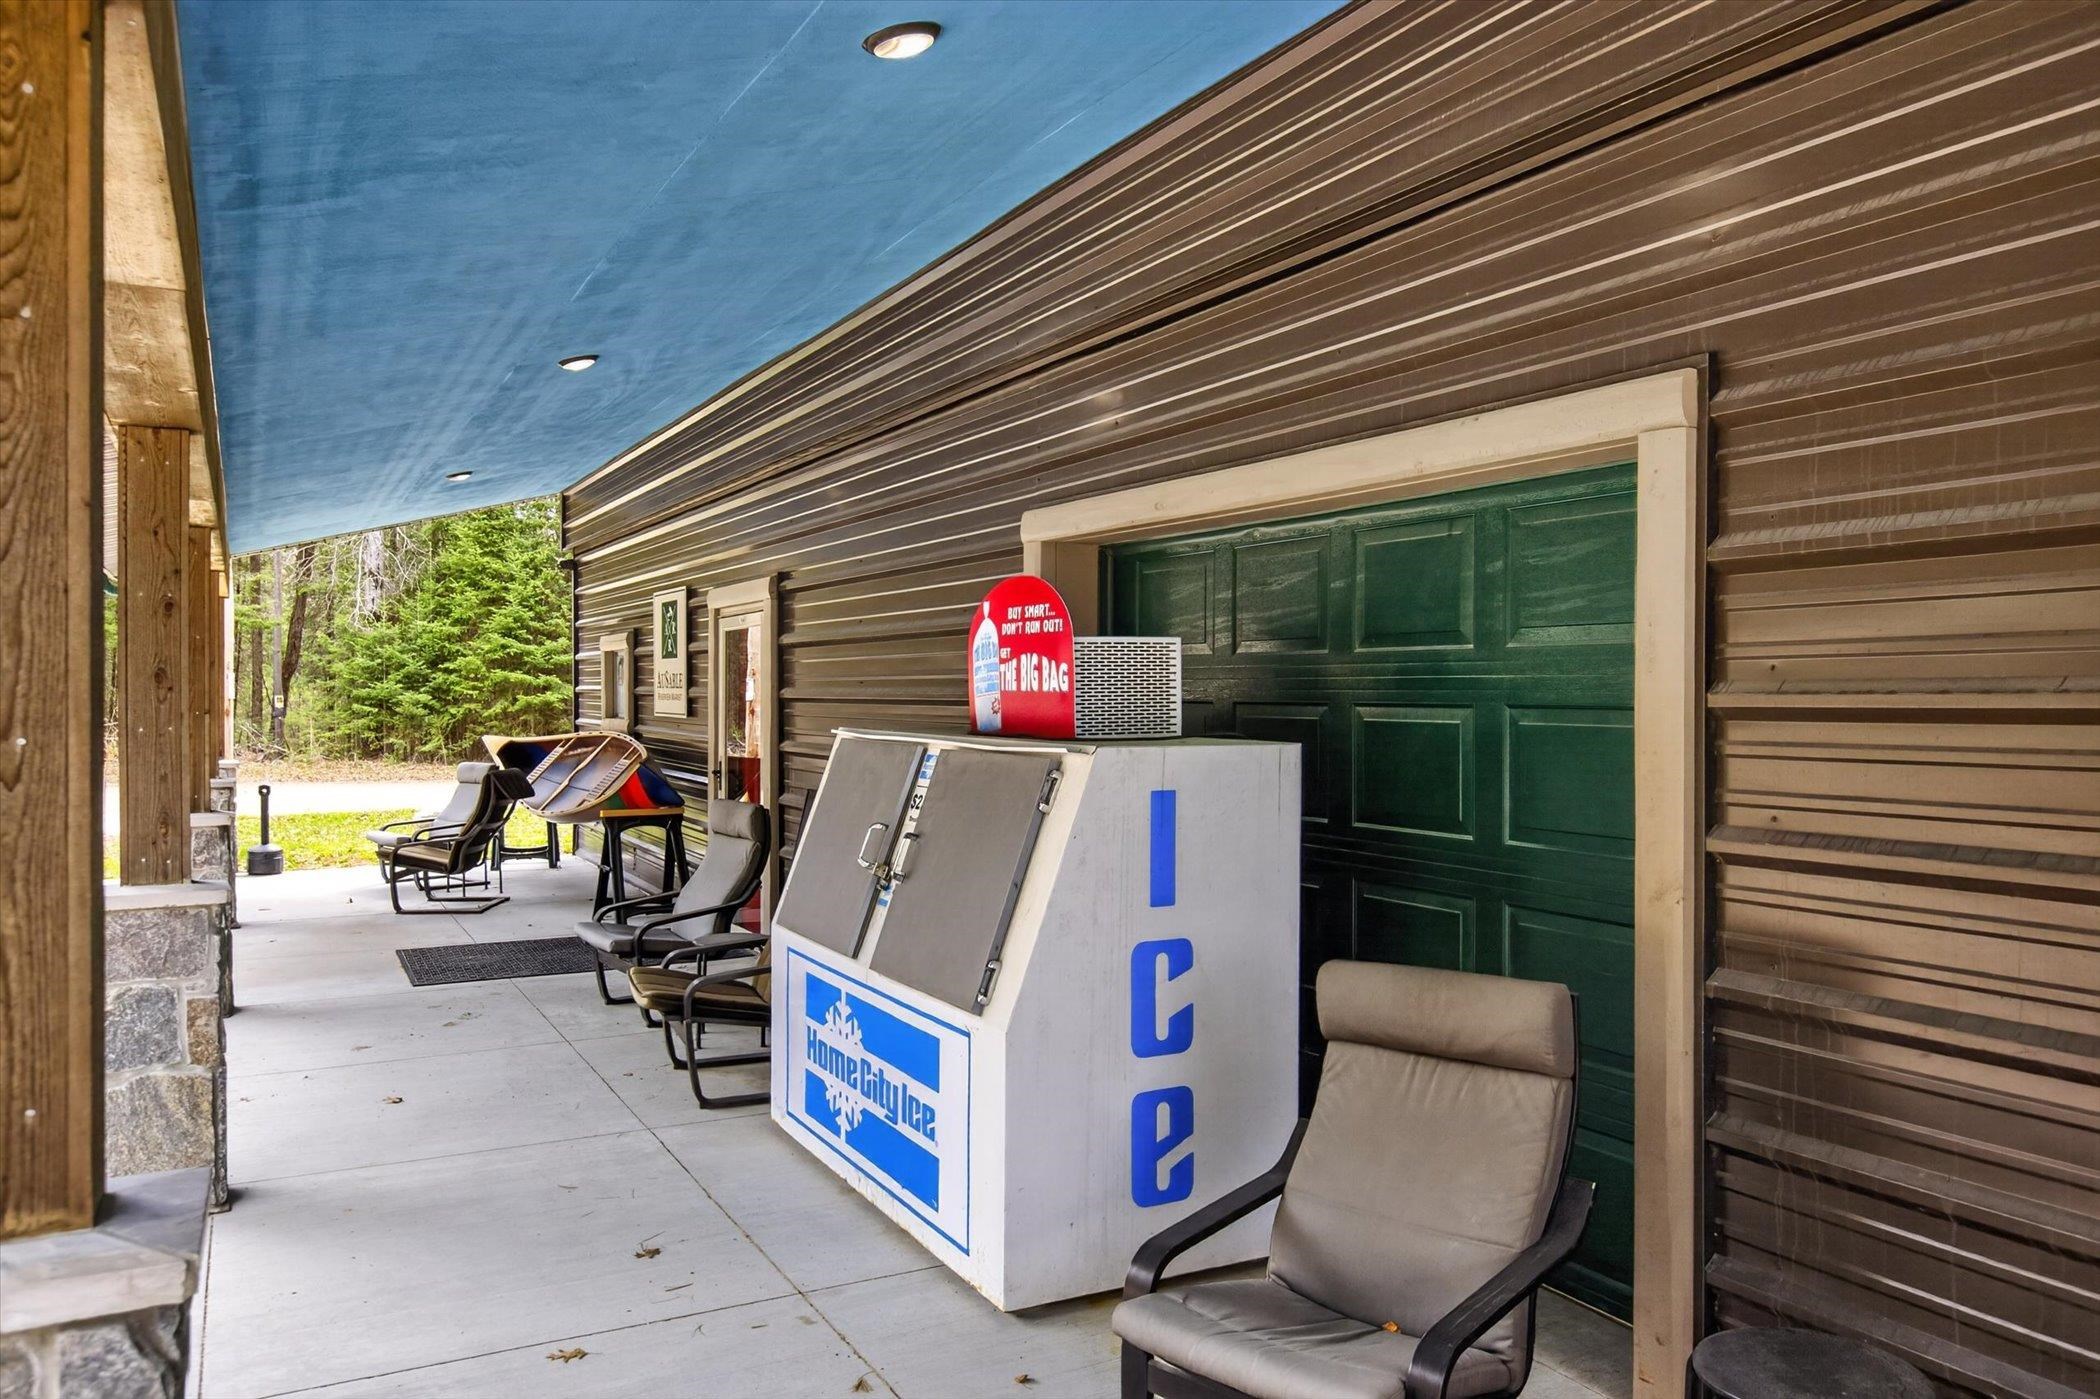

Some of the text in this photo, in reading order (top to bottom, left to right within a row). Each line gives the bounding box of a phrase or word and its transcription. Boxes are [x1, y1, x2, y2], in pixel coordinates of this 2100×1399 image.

[1007, 603, 1055, 620] BUY SMART...
[1001, 618, 1063, 635] DON'T RUN OUT!
[1000, 647, 1011, 659] GET
[1000, 657, 1017, 691] THE
[1020, 652, 1040, 692] BIG
[1042, 655, 1069, 692] BAG
[807, 1025, 936, 1142] Home City Ice
